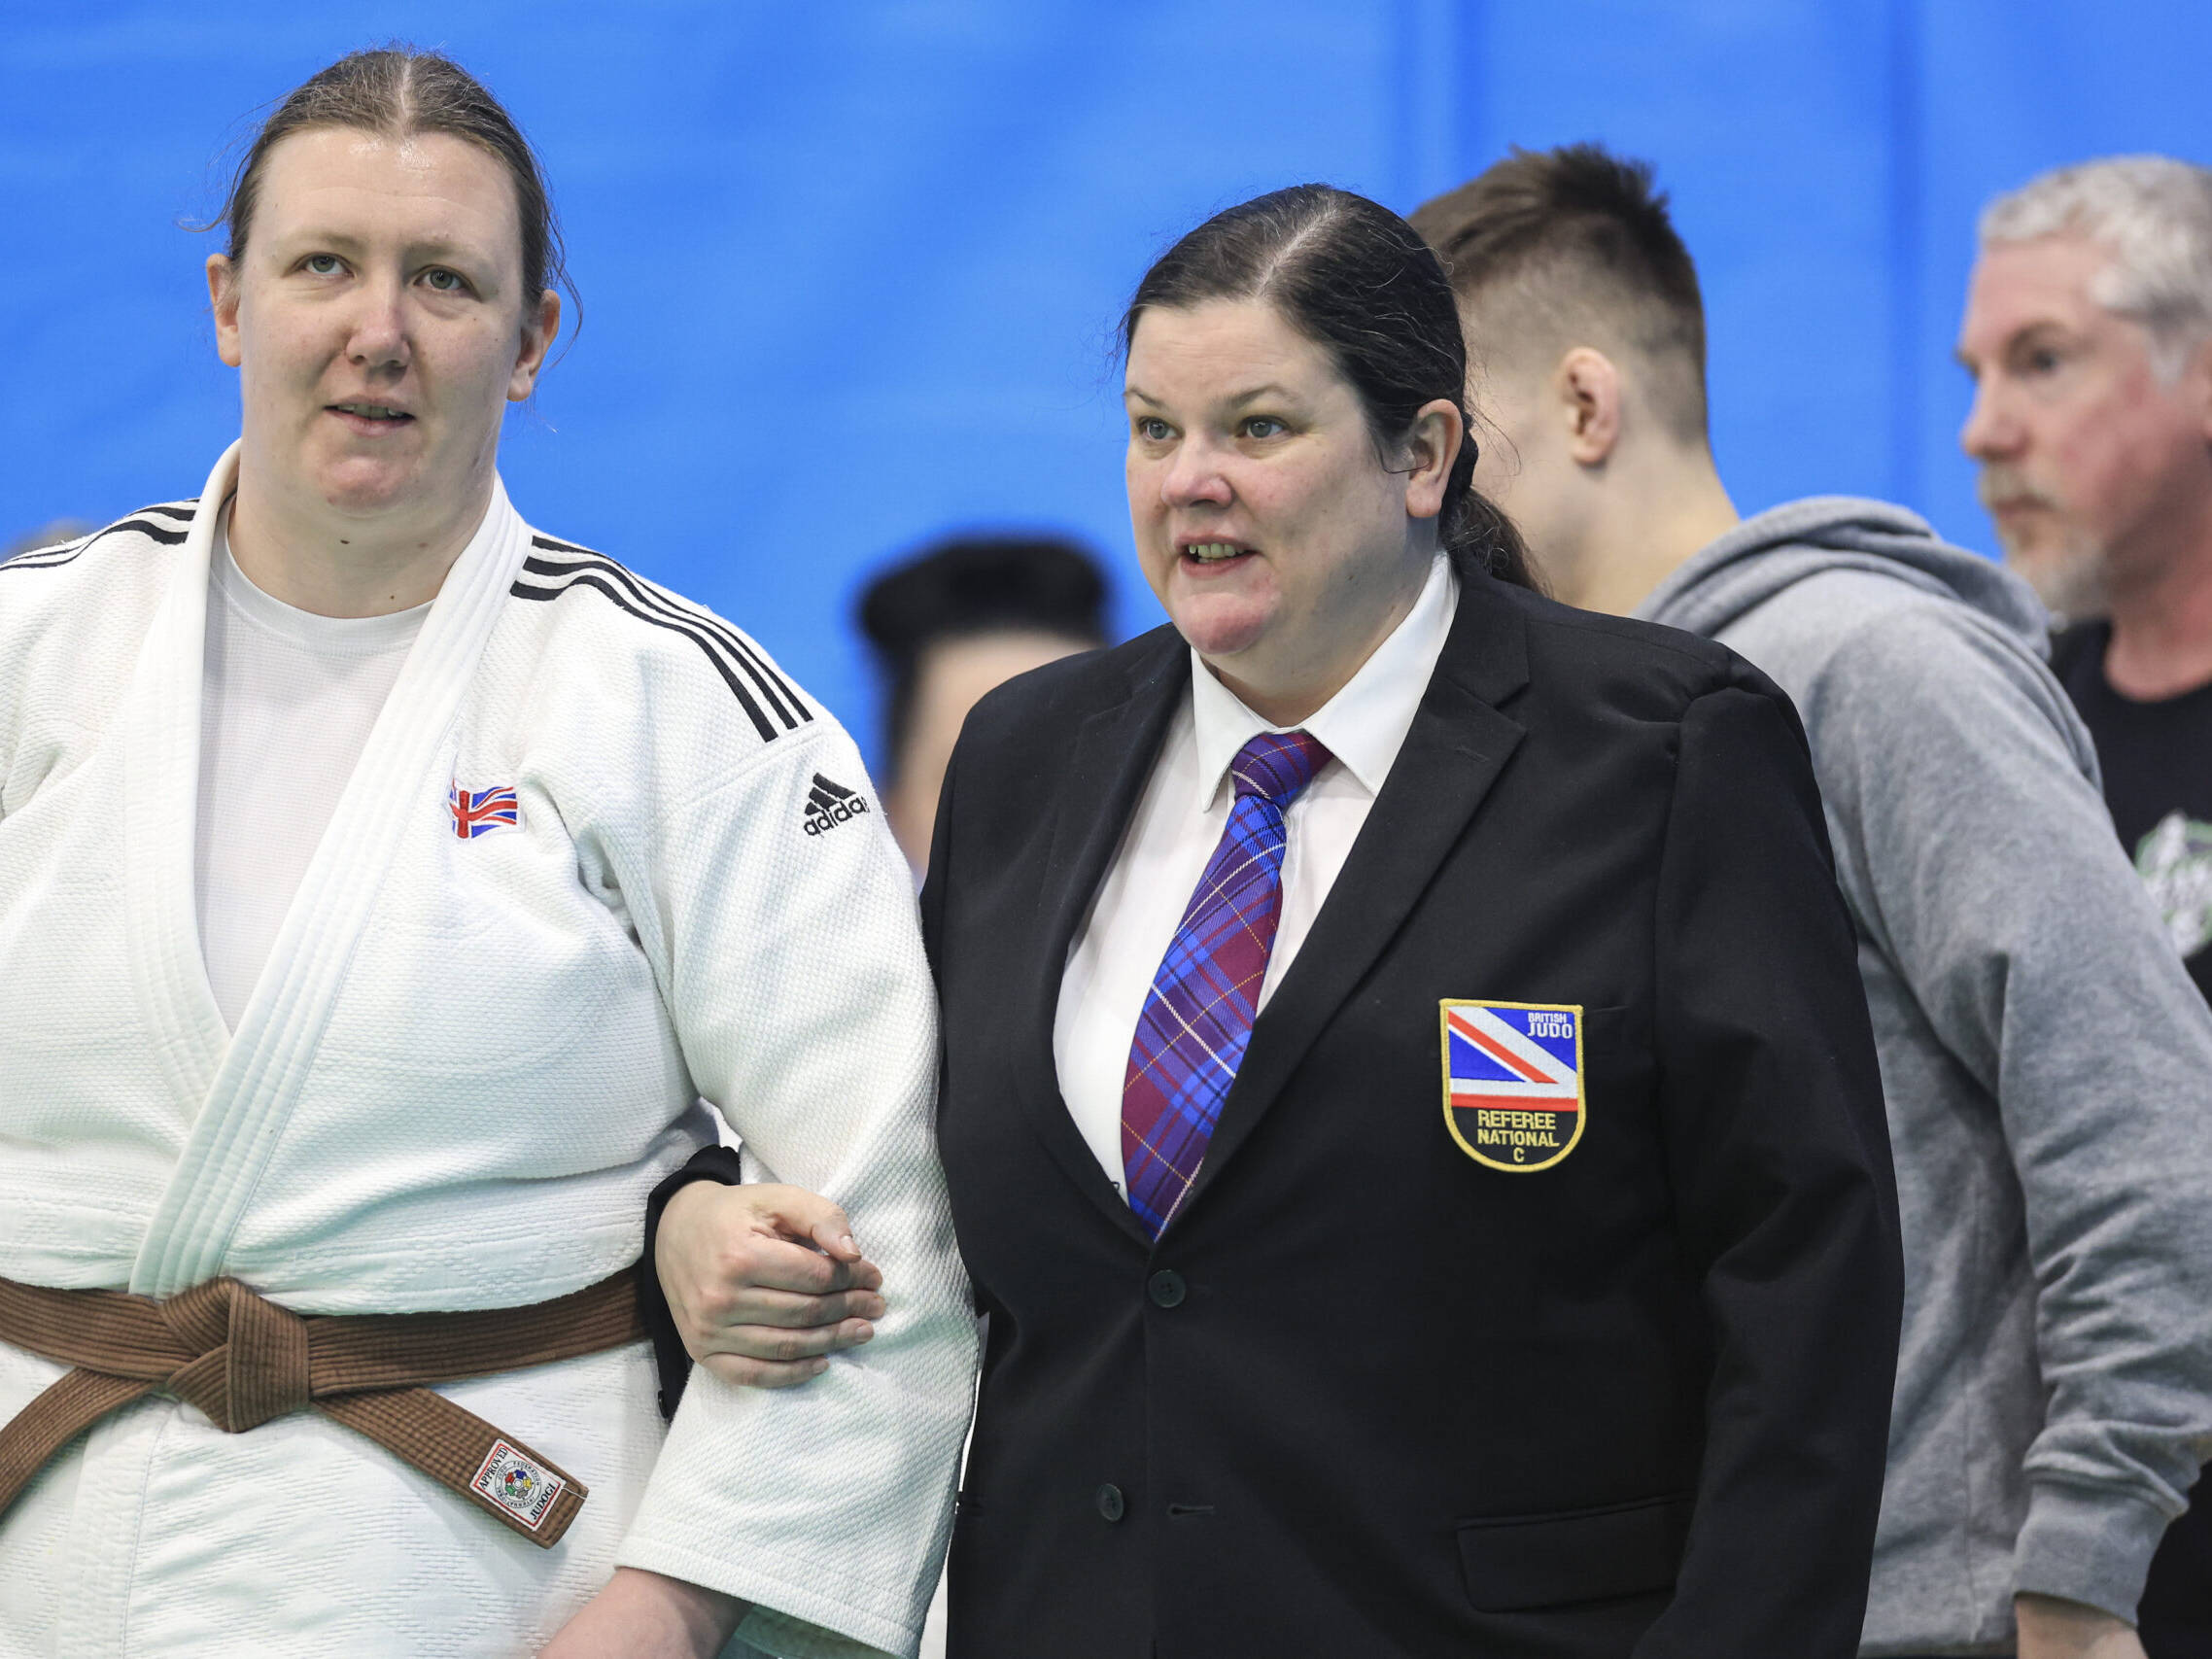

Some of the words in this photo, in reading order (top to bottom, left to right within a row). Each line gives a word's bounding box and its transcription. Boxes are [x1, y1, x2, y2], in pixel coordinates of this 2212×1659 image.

[1528, 1012, 1567, 1023] BRITISH
[1527, 1023, 1573, 1039] JUDO
[1477, 1109, 1556, 1129] REFEREE
[1477, 1128, 1560, 1147] NATIONAL
[1513, 1147, 1525, 1162] C
[478, 1447, 508, 1490] APPROVED
[530, 1482, 556, 1520] JUDOGI
